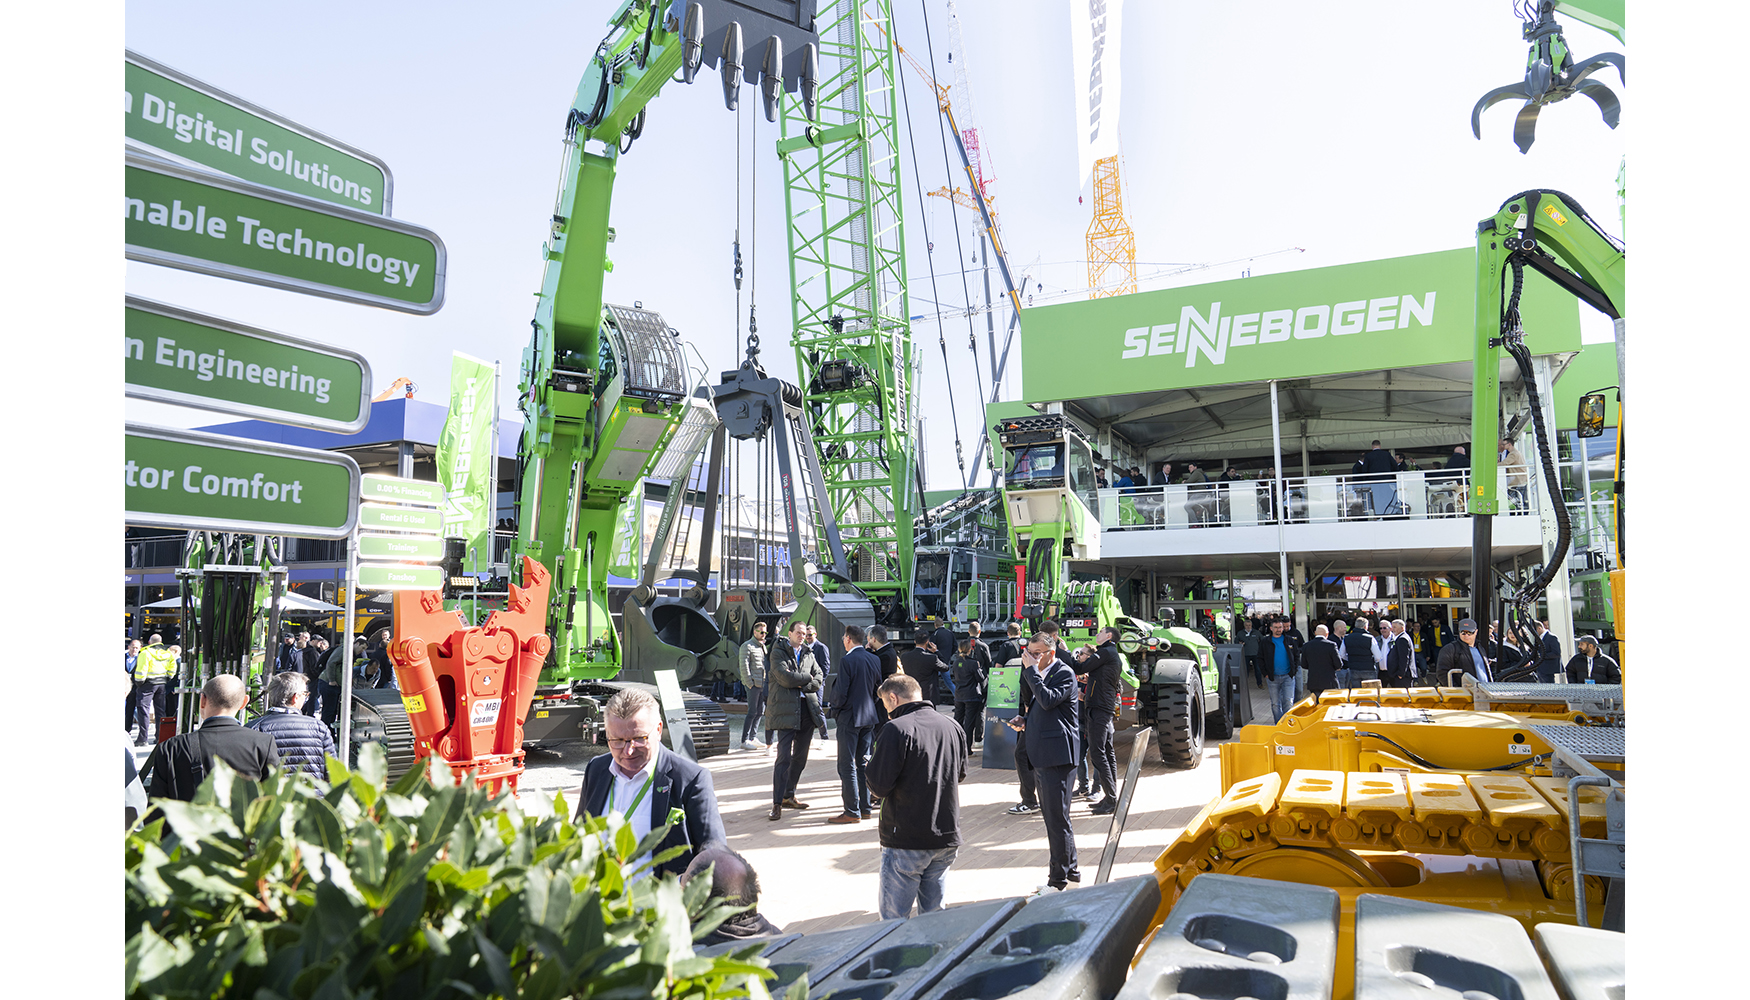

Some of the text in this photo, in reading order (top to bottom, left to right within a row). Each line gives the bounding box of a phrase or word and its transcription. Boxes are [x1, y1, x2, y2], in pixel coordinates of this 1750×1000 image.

[142, 92, 244, 156] Digital
[250, 137, 372, 205] Solutions
[125, 196, 420, 287] nable Technology
[1121, 291, 1437, 368] SENNEBOGEN
[155, 336, 331, 404] Engineering
[894, 335, 906, 431] SENNEBOGEN
[125, 460, 303, 503] tor Comfort
[445, 377, 477, 538] ENNEBOGEN
[380, 513, 402, 522] Rental
[410, 516, 425, 524] Used
[401, 487, 432, 499] Financing
[388, 543, 418, 553] Trainings
[388, 573, 416, 583] Fanshop
[485, 702, 500, 711] MBI
